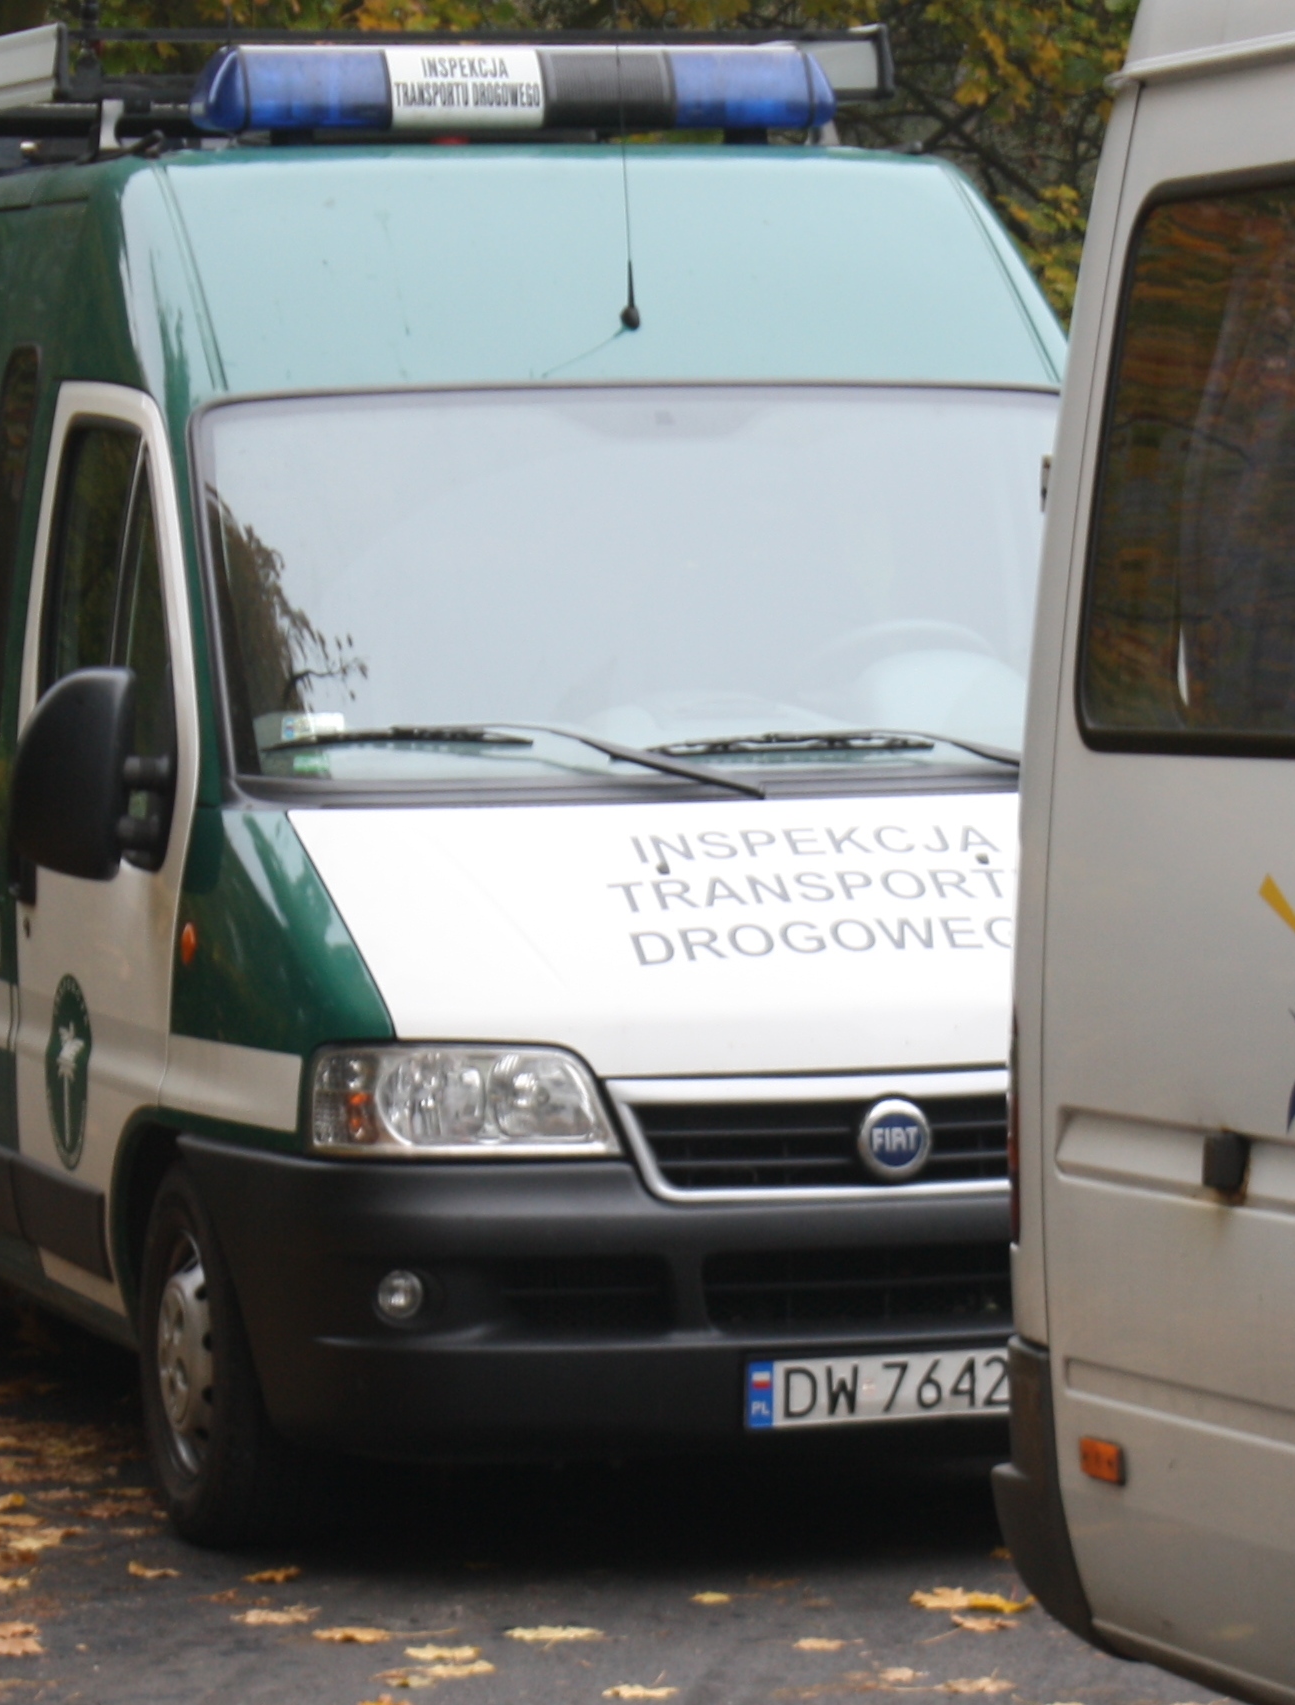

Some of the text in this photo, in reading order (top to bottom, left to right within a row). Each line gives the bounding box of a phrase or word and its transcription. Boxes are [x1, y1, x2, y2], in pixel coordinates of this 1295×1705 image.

[421, 57, 509, 78] INSPEKCJA
[395, 82, 541, 107] TRANSPORTU DROGOWEGO
[629, 825, 1002, 864] INSPEKCJA
[607, 868, 1018, 914] TRANSPORT
[629, 916, 1012, 967] DROGOWEG
[872, 1126, 918, 1152] FIAT
[783, 1356, 1010, 1418] DW 7642
[752, 1401, 770, 1416] PL
